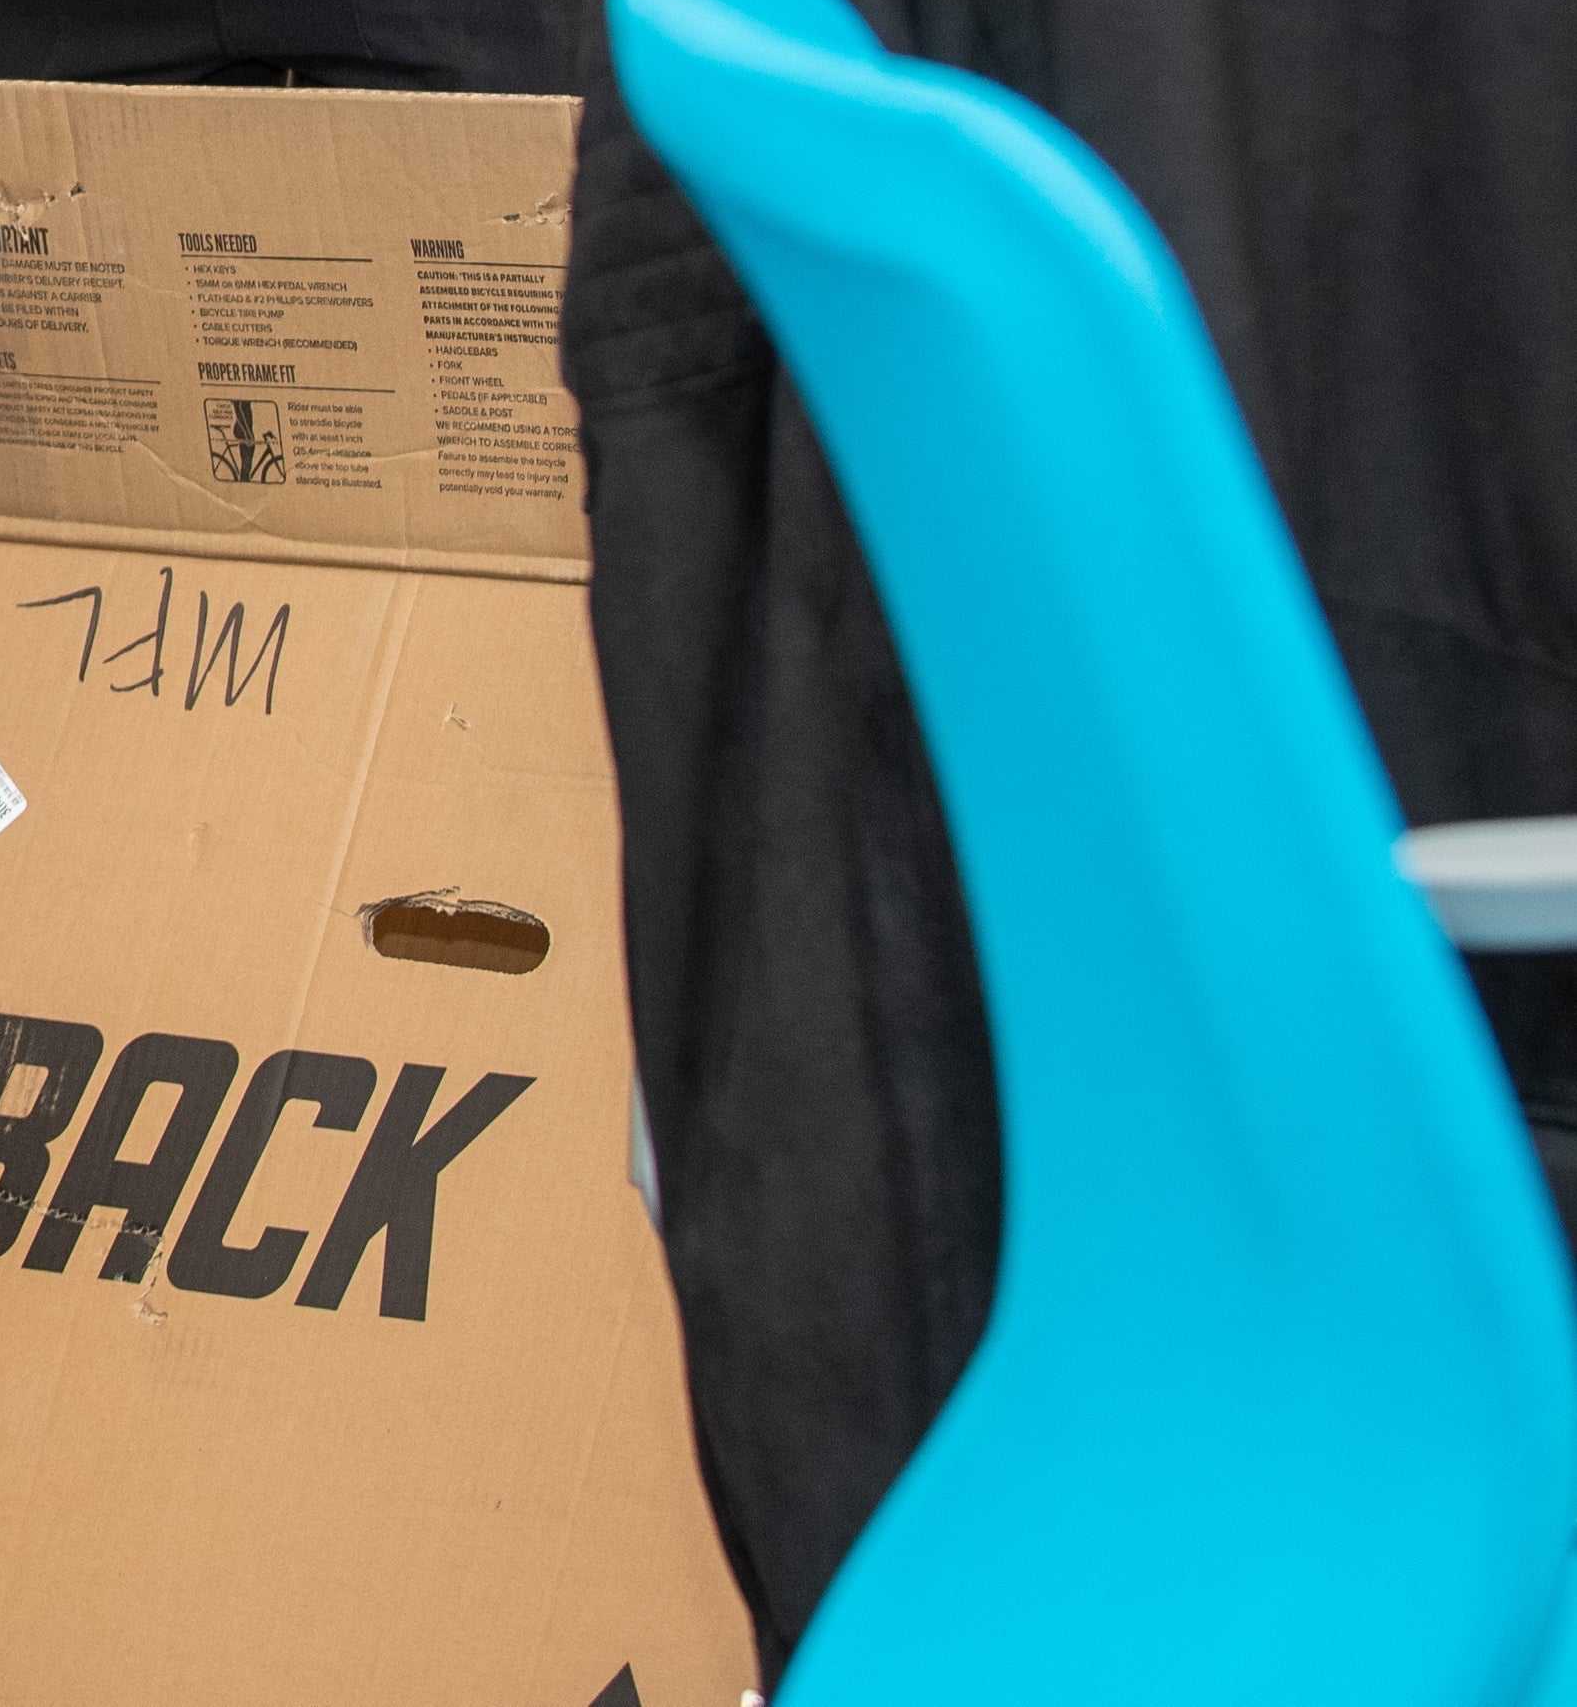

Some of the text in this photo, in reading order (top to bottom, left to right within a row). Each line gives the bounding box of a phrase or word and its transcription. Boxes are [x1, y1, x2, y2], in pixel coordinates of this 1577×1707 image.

[178, 233, 257, 254] TOOLS NEEDED
[411, 238, 464, 259] WARNING
[2, 259, 43, 270] DAMAGE
[45, 261, 72, 271] MUST
[75, 263, 89, 272] BE
[91, 263, 125, 274] NOTED
[193, 265, 236, 274] HEX KEYS
[35, 277, 81, 287] DELIVERY
[83, 279, 125, 289] RECEIPT.
[417, 270, 458, 280] CAUTION:
[483, 273, 491, 281] IS
[492, 274, 499, 282] A
[500, 274, 545, 283] PARTIALLY
[278, 283, 306, 291] PEDAL
[308, 283, 347, 292] WRENCH
[420, 286, 553, 299] ASSEMBLED BICYCLE REQUIRING
[7, 290, 46, 301] AGAINST
[51, 293, 58, 301] A
[61, 293, 102, 303] CARRIER
[198, 294, 243, 303] FLATHEAD
[266, 297, 304, 305] PHILLIPS
[305, 297, 373, 307] SCREWDRIVERS
[2, 304, 14, 312] BE
[16, 304, 42, 315] FILED
[45, 306, 79, 317] WITHIN
[200, 308, 236, 317] BICYCLE
[258, 310, 284, 318] PUMP
[422, 300, 559, 314] ATTACHMENT OF THE FOLLOWING
[25, 320, 39, 329] OF
[41, 321, 89, 333] DELIVERY.
[202, 323, 272, 333] CABLE CUTTERS
[424, 315, 451, 324] PARTS
[452, 316, 462, 325] IN
[464, 317, 520, 327] ACCORDANCE
[522, 319, 544, 328] WITH
[425, 330, 502, 342] MANUFACTURER'S
[203, 337, 357, 352] TORQUE WRENCH (RECOMMENDED)
[436, 346, 498, 357] HANDLEBARS
[438, 361, 462, 370] FORK
[198, 362, 296, 383] PROPER FRAME FIT
[439, 376, 504, 387] FRONT WHEEL
[441, 391, 547, 405] PEDALS (IF APPLICABLE)
[287, 402, 309, 412] Rider
[311, 404, 331, 412] must
[332, 404, 343, 413] be
[443, 406, 513, 418] SADDLE & POST
[289, 417, 299, 426] to
[334, 419, 362, 429] bicycle
[435, 421, 450, 430] WE
[452, 421, 510, 433] RECOMMEND
[513, 424, 541, 435] USING
[543, 425, 550, 434] A
[437, 436, 476, 446] WRENCH
[479, 437, 491, 447] TO
[493, 438, 540, 449] ASSEMBLE
[438, 450, 566, 468] Failure to assemble the bicycle
[439, 467, 568, 483] correctly may lead to injury and
[439, 483, 564, 501] potentially void your warranty.
